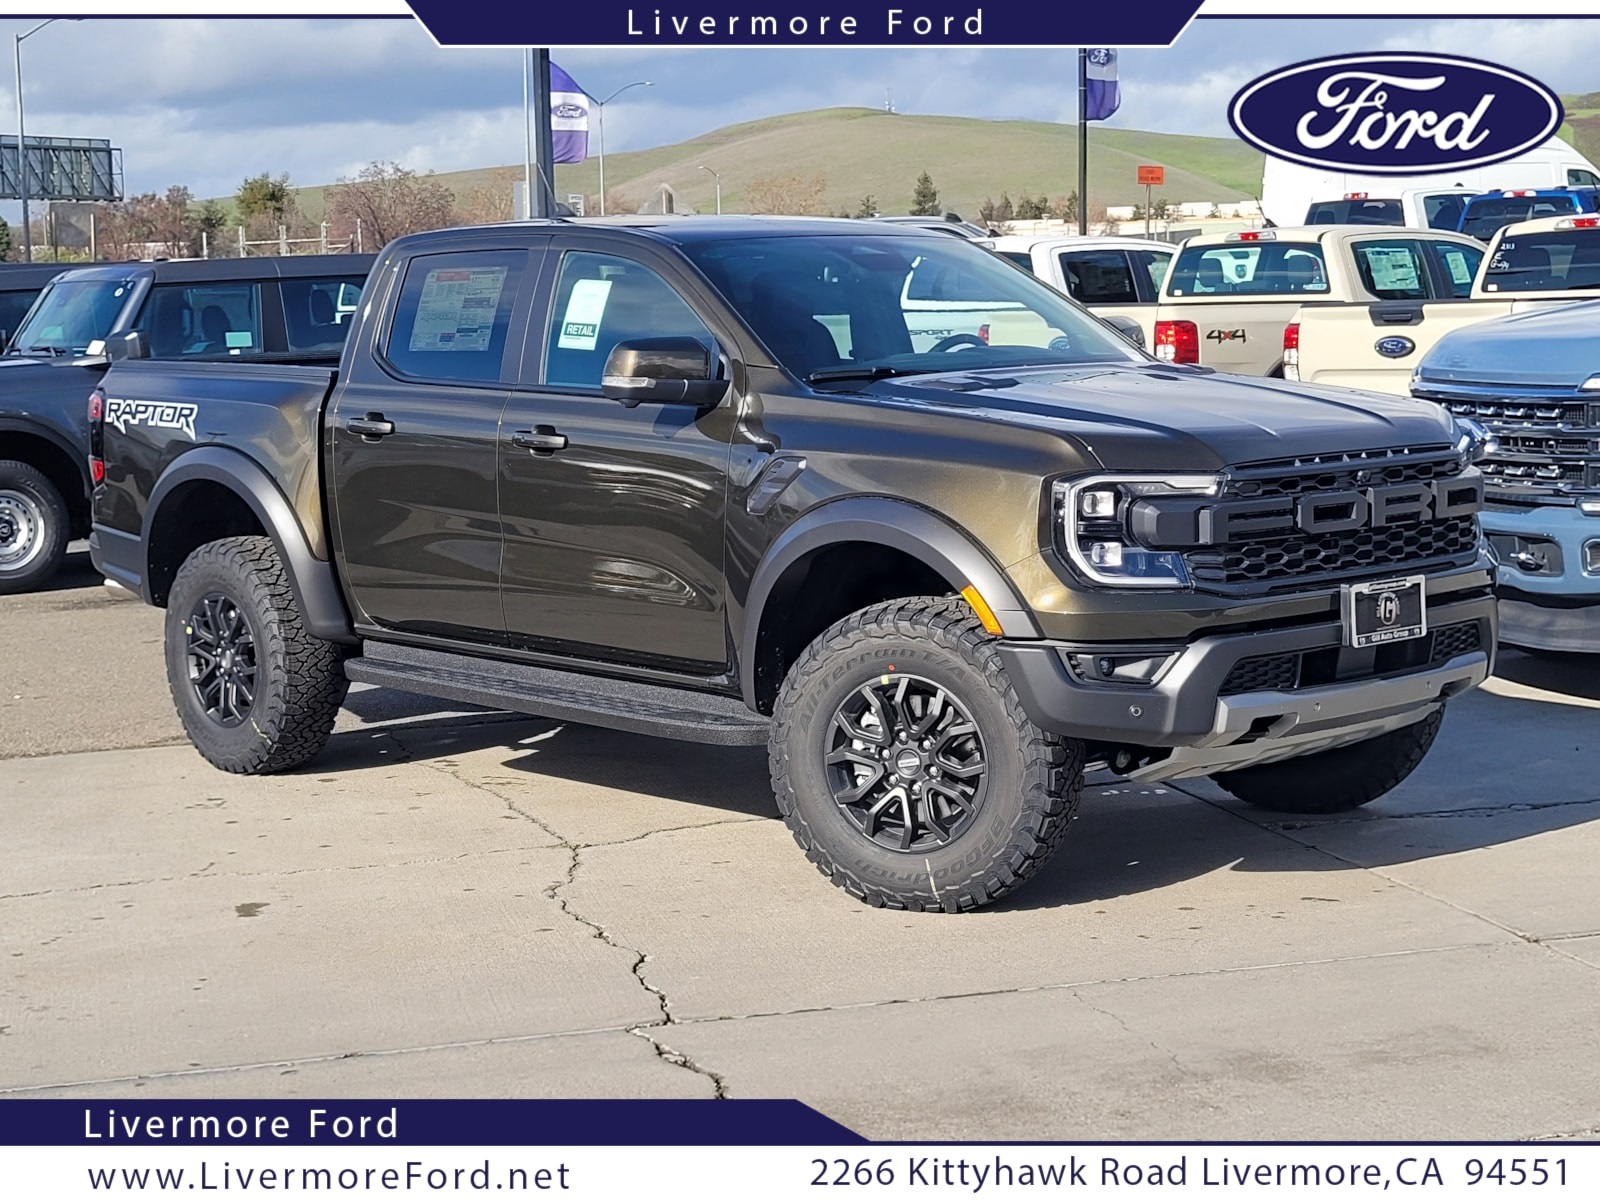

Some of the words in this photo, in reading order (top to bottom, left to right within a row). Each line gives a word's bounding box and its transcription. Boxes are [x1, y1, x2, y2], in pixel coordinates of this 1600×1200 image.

[556, 105, 582, 117] Ford
[566, 323, 594, 336] RETAIL
[908, 328, 955, 336] SPORT
[104, 398, 199, 441] RAPTOR
[1199, 477, 1485, 545] FORD
